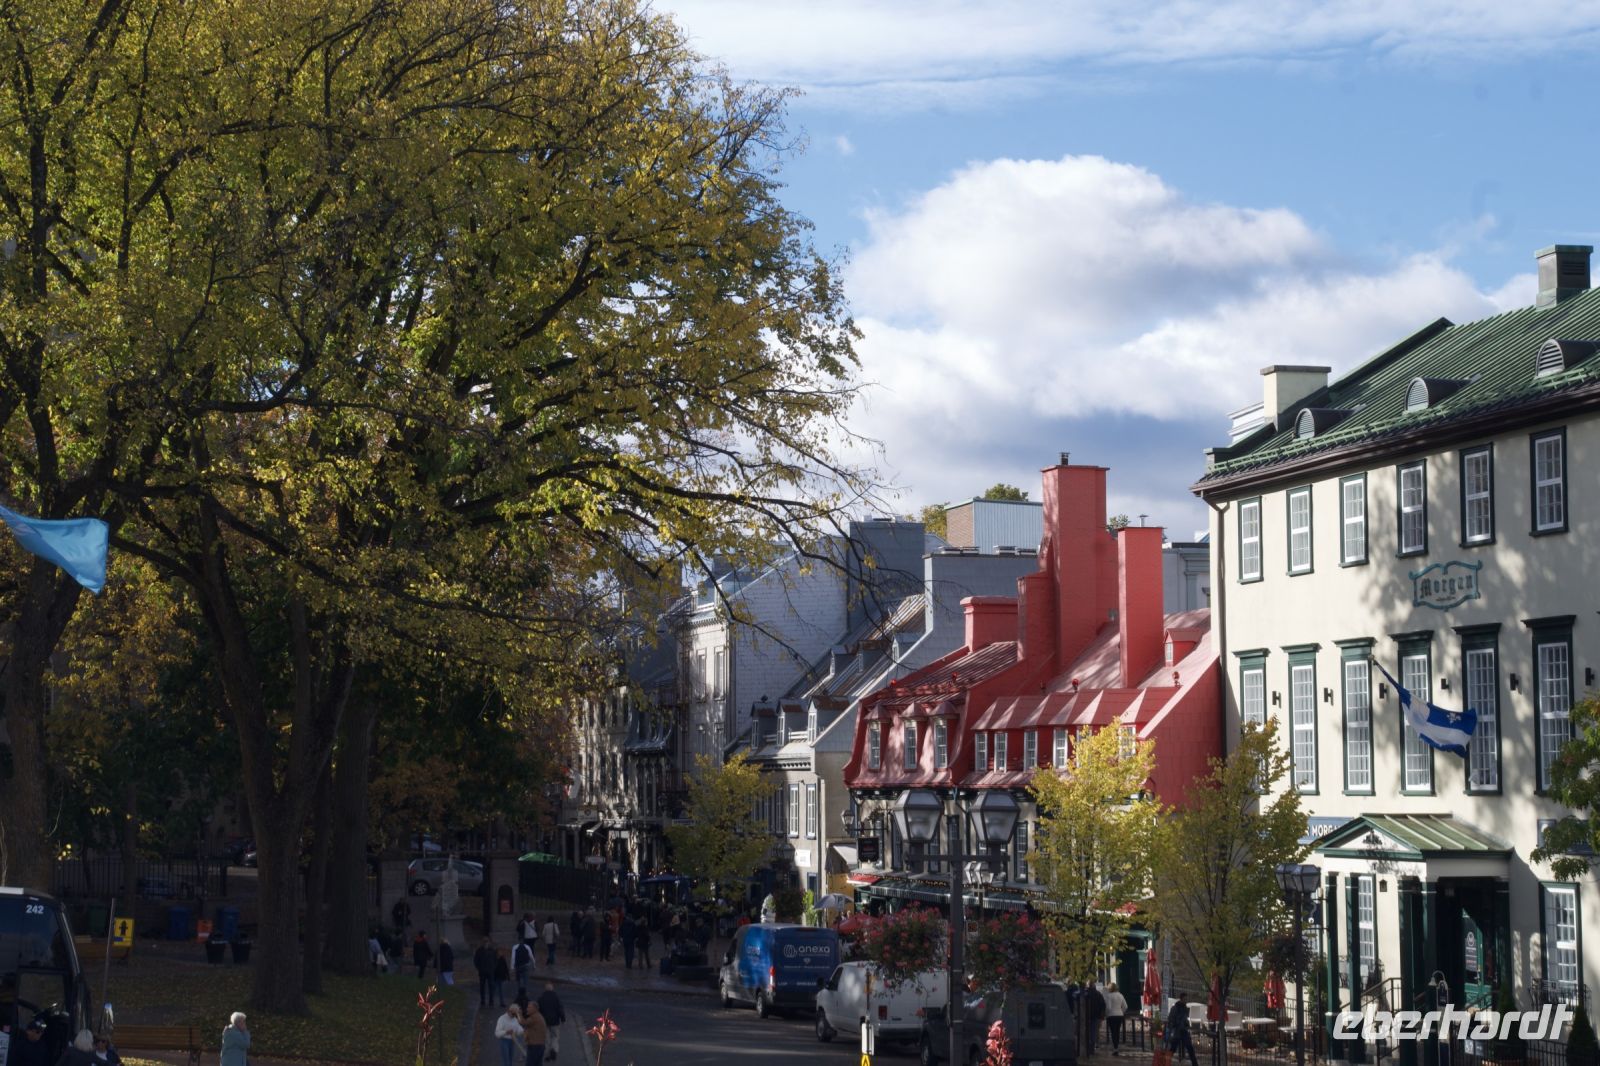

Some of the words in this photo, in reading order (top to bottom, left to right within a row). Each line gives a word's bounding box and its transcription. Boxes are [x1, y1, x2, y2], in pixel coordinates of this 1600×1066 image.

[1420, 575, 1472, 598] Morgan
[26, 904, 44, 915] 242
[798, 945, 830, 953] anexa
